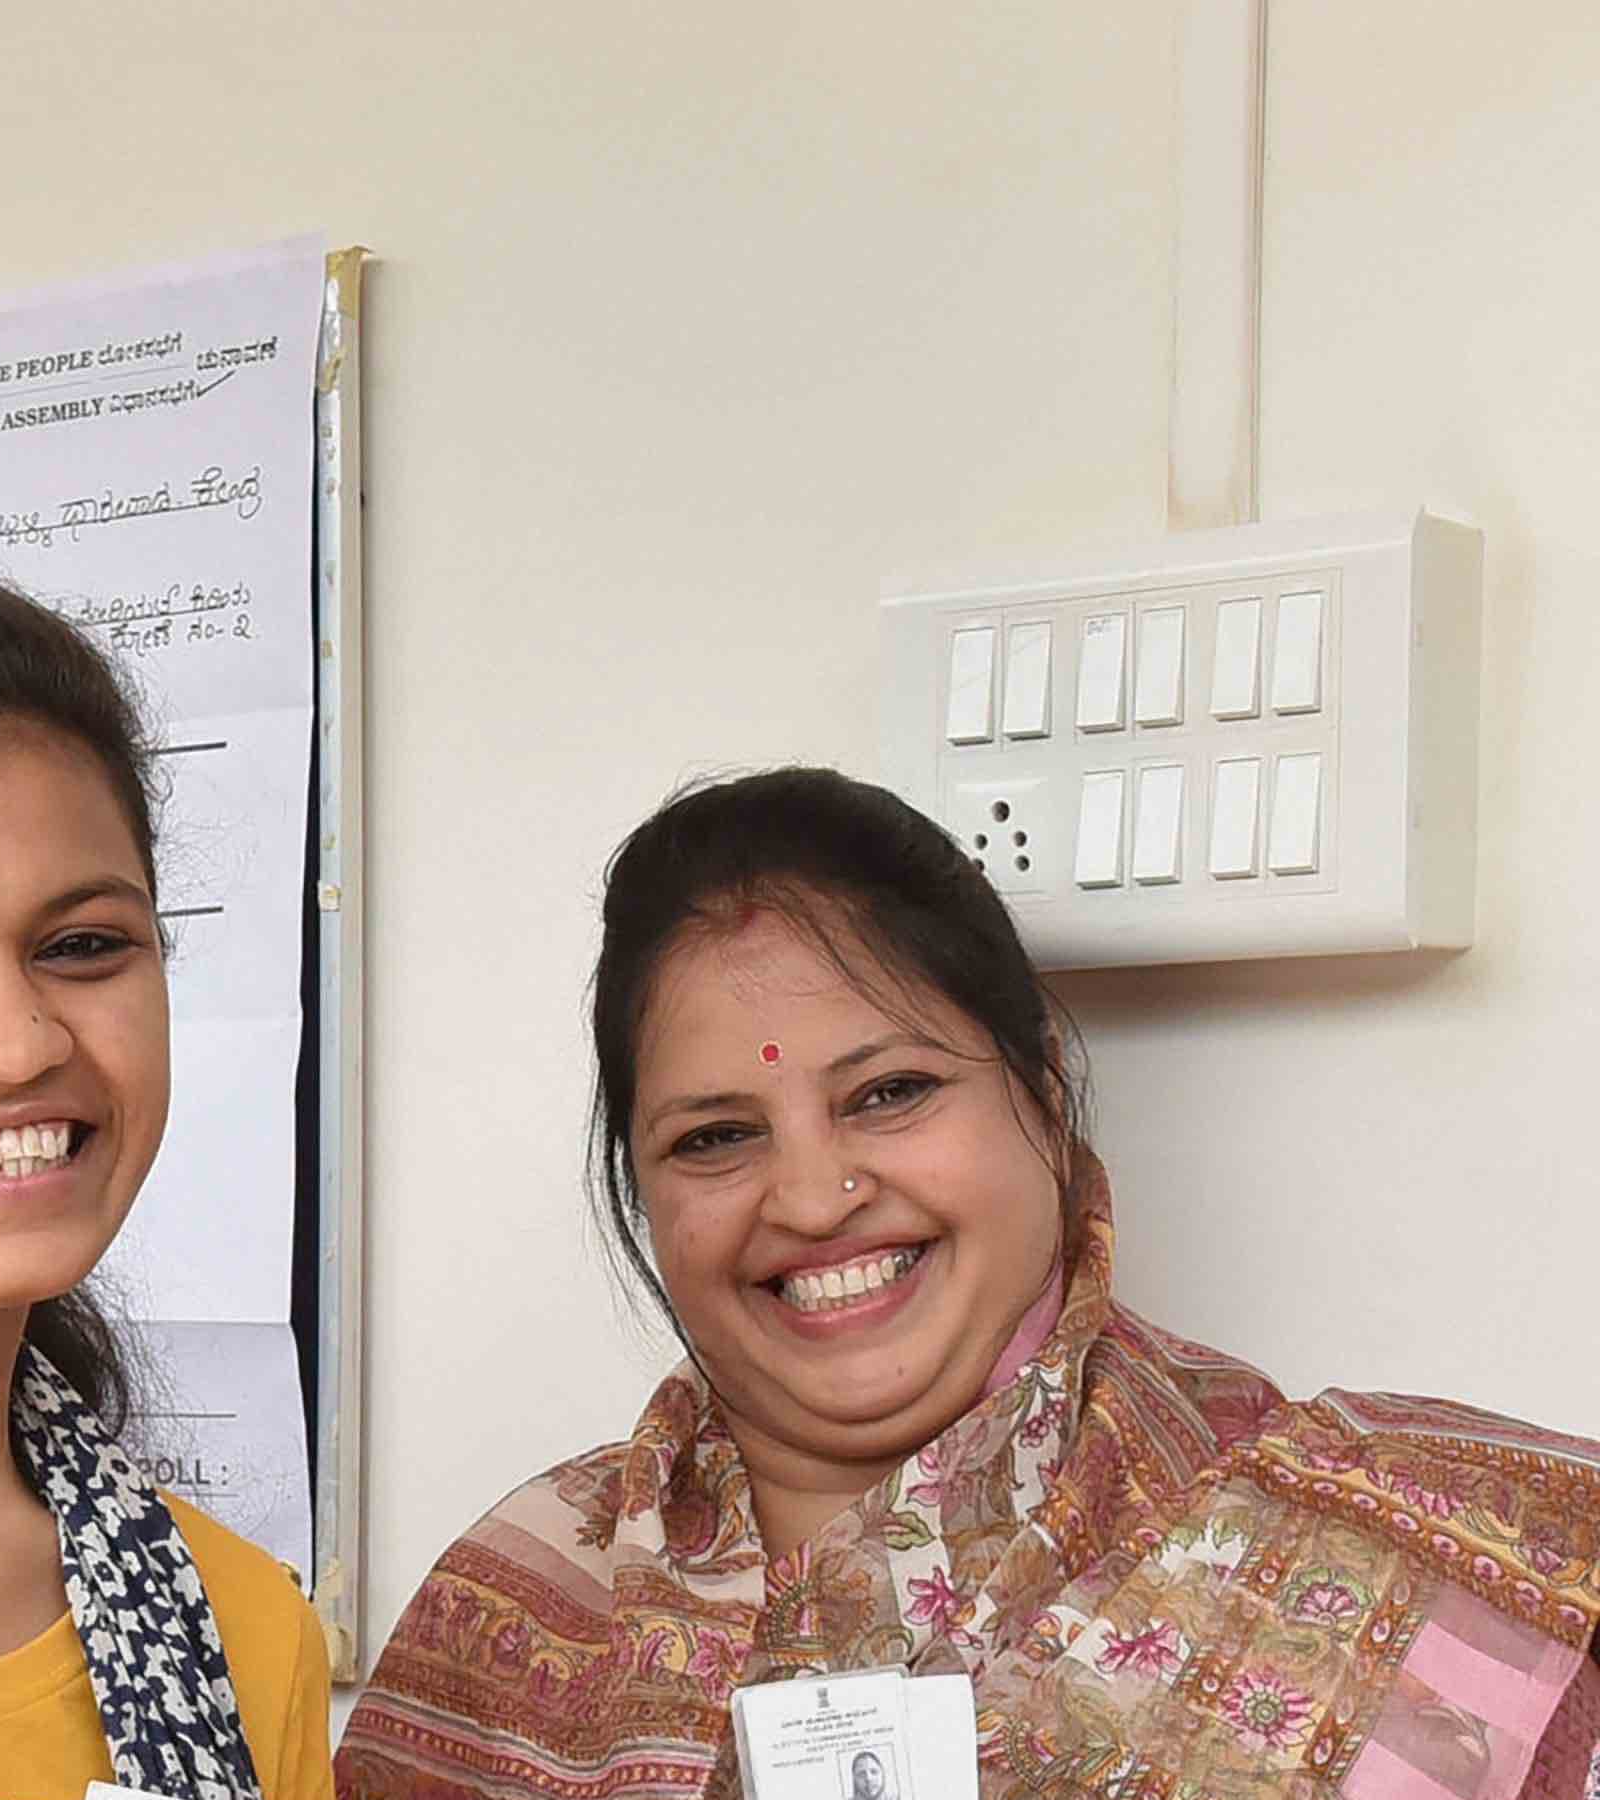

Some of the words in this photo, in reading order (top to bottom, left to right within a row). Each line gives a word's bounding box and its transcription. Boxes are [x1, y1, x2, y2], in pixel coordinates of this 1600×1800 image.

[16, 350, 94, 380] PEOPLE
[1, 397, 103, 431] ASSEMBLY
[139, 1456, 211, 1486] POLL
